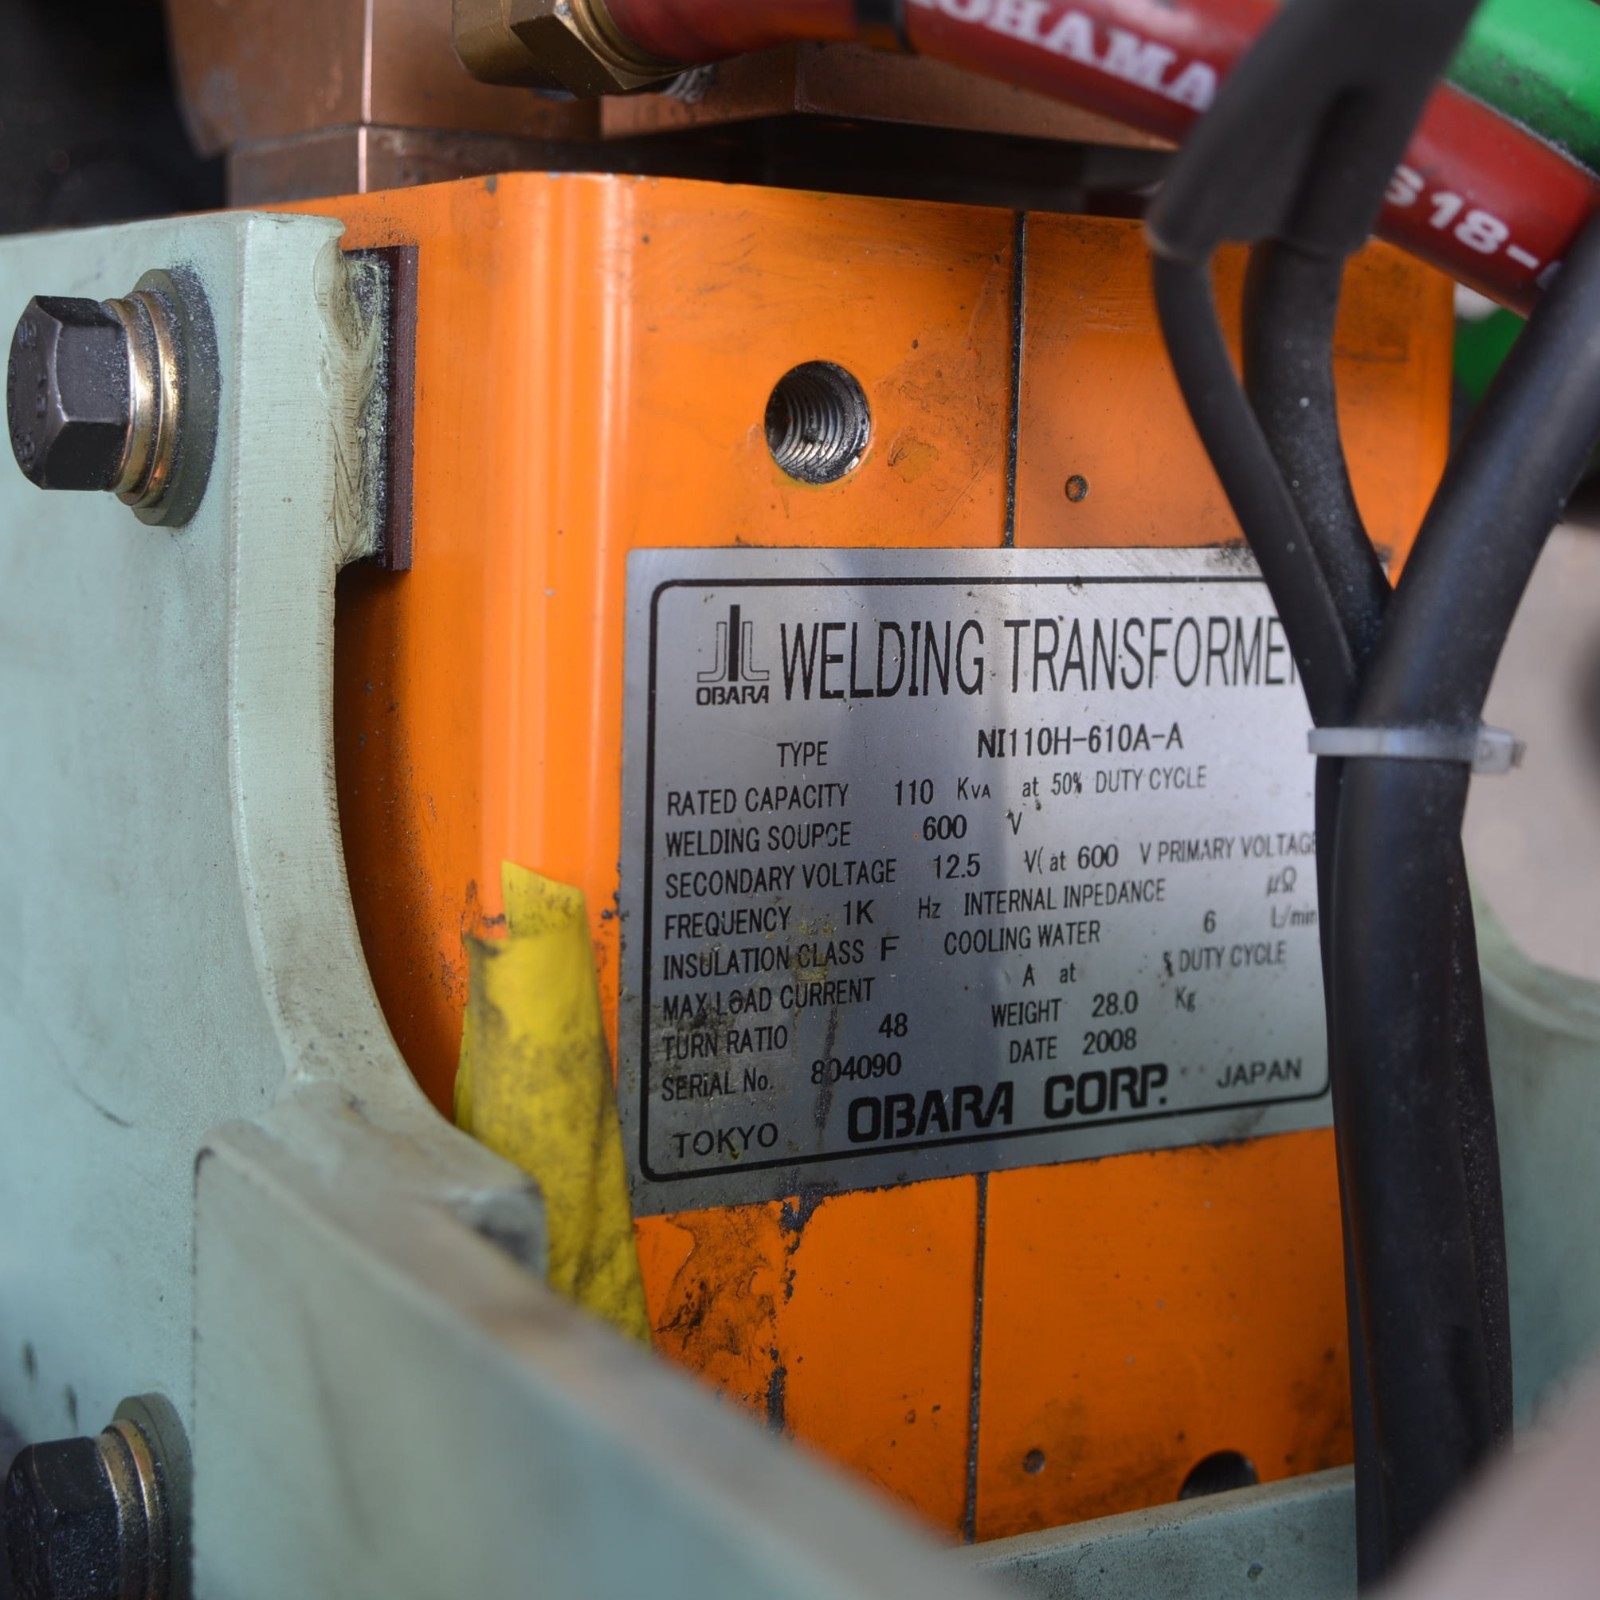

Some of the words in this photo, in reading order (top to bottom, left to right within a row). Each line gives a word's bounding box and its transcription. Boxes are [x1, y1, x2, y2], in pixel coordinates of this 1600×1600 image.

[903, 0, 1217, 111] OHAMA
[780, 619, 984, 701] WELDING
[1004, 616, 1294, 693] TRANSFORME
[696, 685, 769, 705] OBARA
[777, 741, 828, 767] TYPE
[667, 789, 736, 816] RATED
[745, 783, 849, 812] CAPACITY
[895, 779, 934, 806] 110
[1022, 776, 1039, 797] at
[1051, 771, 1082, 795] 50%
[1095, 769, 1143, 794] DUTY
[1150, 765, 1207, 790] CYCLE
[666, 827, 760, 857] WELDING
[922, 815, 967, 841] 600
[1008, 811, 1022, 835] V
[665, 865, 795, 899] SECONDARY
[802, 859, 897, 888] VOLTAGE
[933, 854, 981, 880] 12.5
[1078, 844, 1119, 870] 600
[1140, 842, 1151, 865] V
[1158, 837, 1236, 863] PRIMARY
[1241, 832, 1315, 858] VOLTAG
[664, 906, 792, 940] FREQUENCY
[843, 900, 875, 926] 1K
[918, 897, 941, 919] Hz
[964, 888, 1057, 916] INTERNAL
[1063, 878, 1167, 908] INPEDANCE
[944, 929, 1031, 956] COOLING
[1037, 920, 1100, 947] WATER
[1203, 910, 1216, 934] 6
[663, 948, 790, 980] INSULATION
[799, 940, 864, 968] CLASS
[880, 936, 900, 961] F
[1022, 963, 1035, 987] A
[1059, 962, 1076, 984] at
[1179, 947, 1224, 973] DUTY
[1231, 941, 1287, 967] CYCLE
[663, 993, 708, 1022] MAX
[717, 987, 772, 1014] LOAD
[780, 977, 875, 1008] CURRENT
[991, 999, 1062, 1028] WEIGHT
[1092, 991, 1139, 1018] 28.0
[662, 1033, 718, 1062] TURN
[726, 1025, 788, 1054] RATIO
[878, 1013, 908, 1038] 48
[1009, 1037, 1058, 1064] DATE
[1083, 1028, 1137, 1056] 2008
[661, 1071, 737, 1102] SERIAL
[743, 1067, 774, 1092] No.
[811, 1052, 902, 1085] 804090
[673, 1123, 778, 1158] TOKYO
[848, 1081, 1014, 1144] OBARA
[1044, 1063, 1168, 1119] CORP.
[1217, 1059, 1302, 1089] JAPAN
